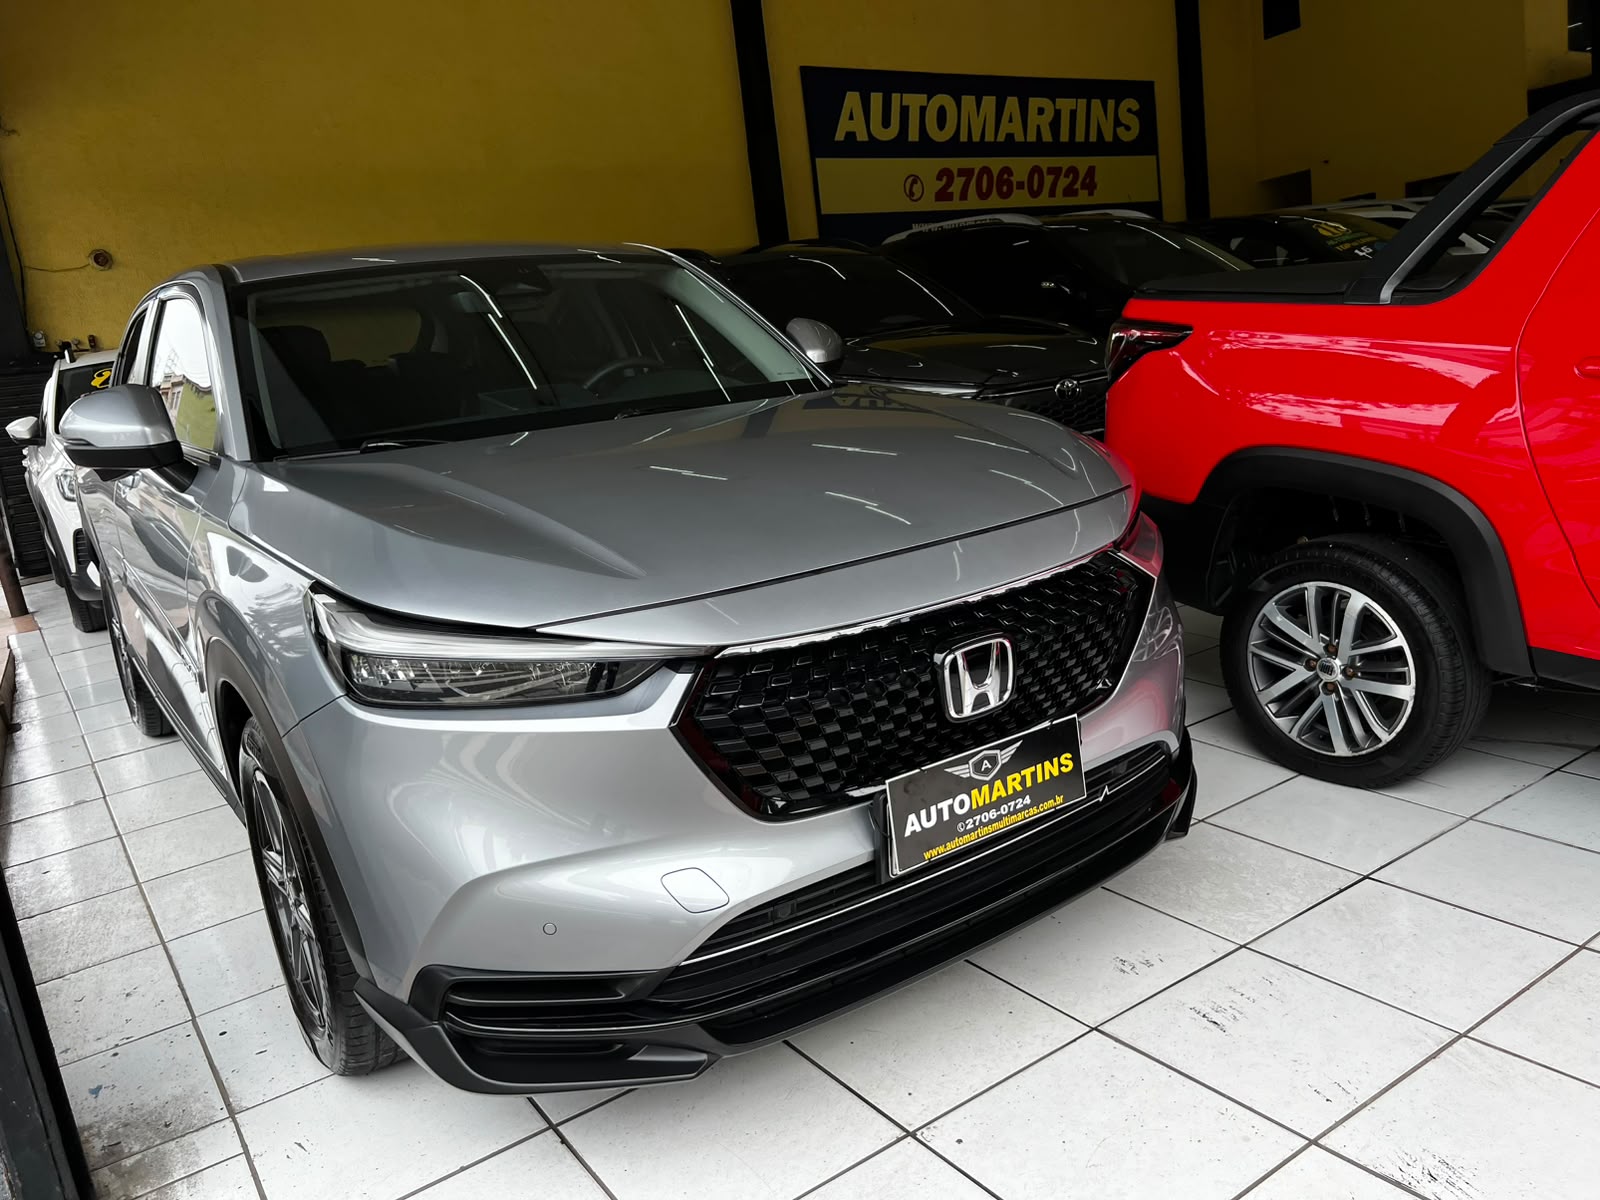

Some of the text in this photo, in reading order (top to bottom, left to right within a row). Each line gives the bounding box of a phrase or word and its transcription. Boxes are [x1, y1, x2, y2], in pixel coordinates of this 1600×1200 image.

[834, 91, 1141, 143] AUTOMARTINS
[934, 165, 1098, 202] 2706-0724
[981, 759, 992, 771] A
[904, 752, 1074, 838] AUTOMARTINS
[965, 795, 1032, 831] 2706-0724
[923, 794, 1064, 861] www.automartinsmultimarcas.com.br
